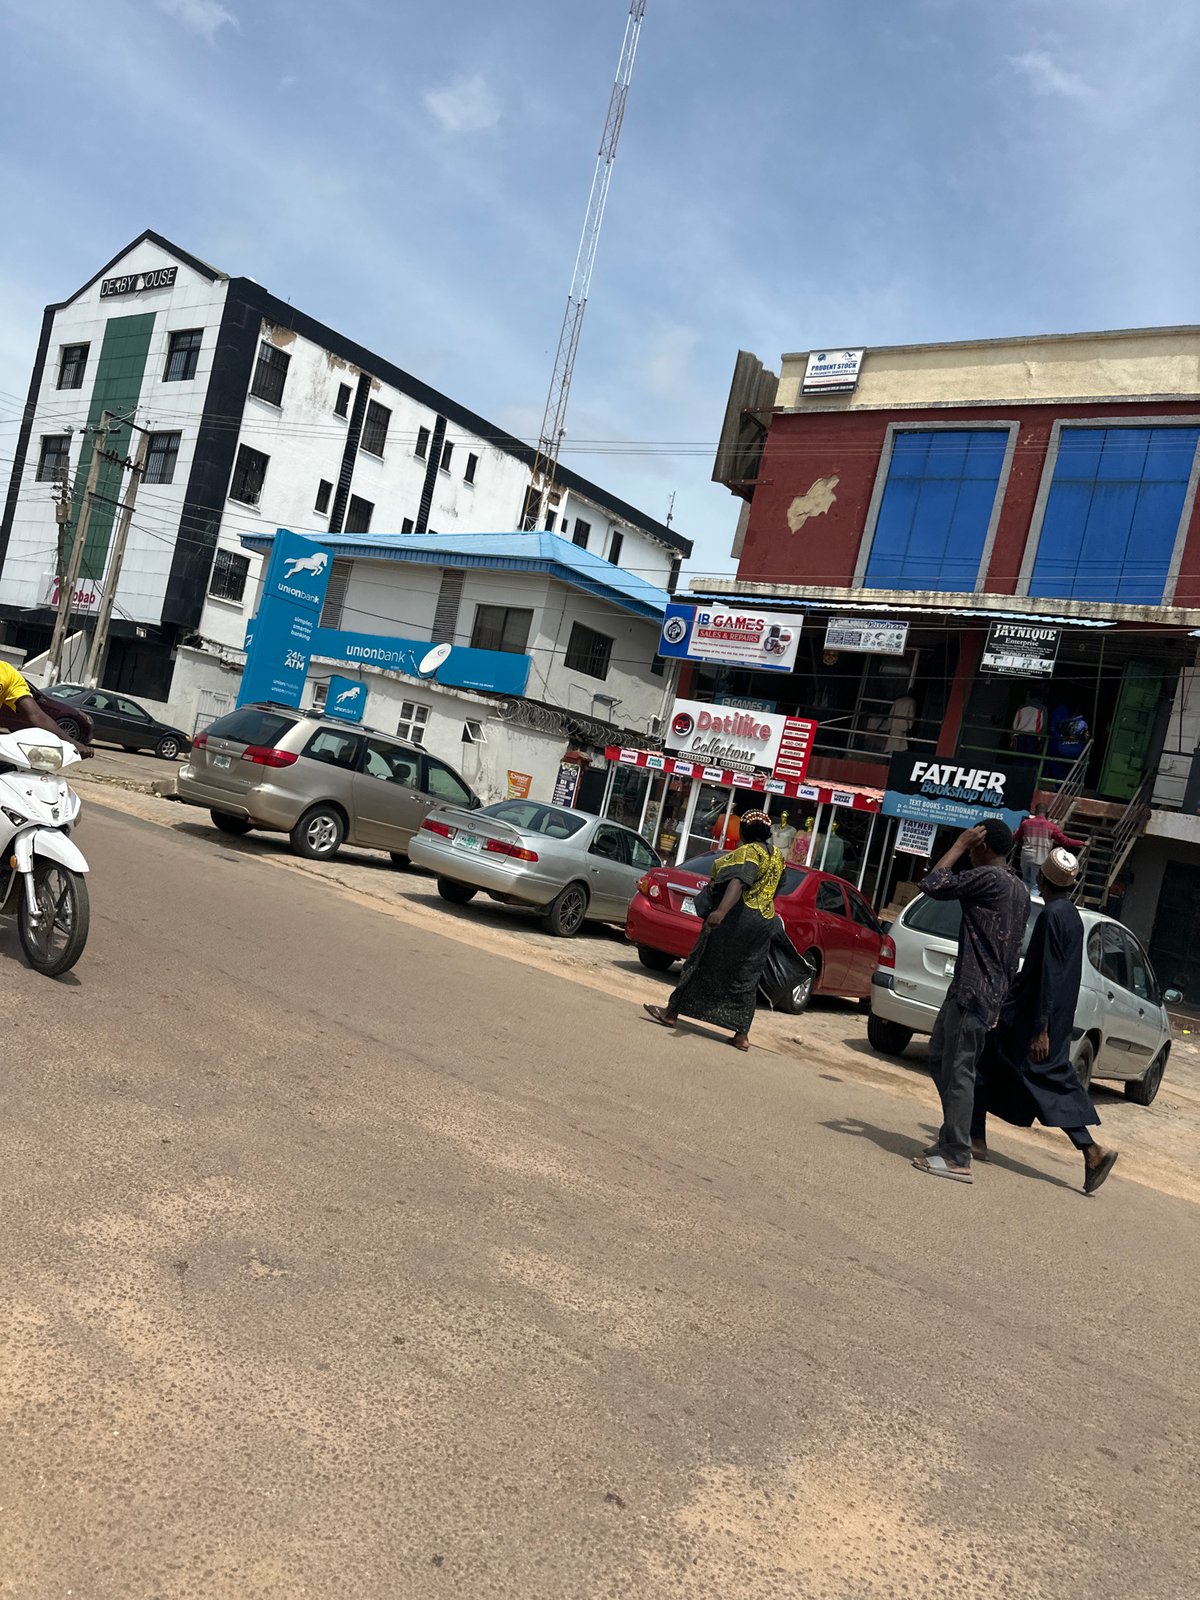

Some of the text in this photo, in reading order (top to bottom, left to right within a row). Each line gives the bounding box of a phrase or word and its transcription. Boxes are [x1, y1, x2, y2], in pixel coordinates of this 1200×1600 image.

[101, 276, 135, 296] DERBY
[278, 583, 320, 605] unionbank
[697, 613, 765, 632] IB GAMES
[699, 629, 759, 643] SALES & REPAIRS
[993, 624, 1057, 642] JAYNIQUE
[1005, 637, 1040, 647] Enterprise
[286, 648, 306, 661] 24hr
[346, 644, 406, 664] unionbank
[284, 658, 305, 672] ATM
[696, 710, 772, 742] Datilike
[691, 736, 756, 762] Collections
[909, 761, 1007, 795] FATHER
[920, 781, 980, 802] Bookshop
[909, 798, 922, 807] TEXT
[922, 800, 941, 810] BOOKS
[944, 804, 979, 816] STATIONARY
[983, 810, 1004, 820] BIBLES
[902, 826, 932, 837] BOOKSHOP
[904, 820, 933, 831] FATHER
